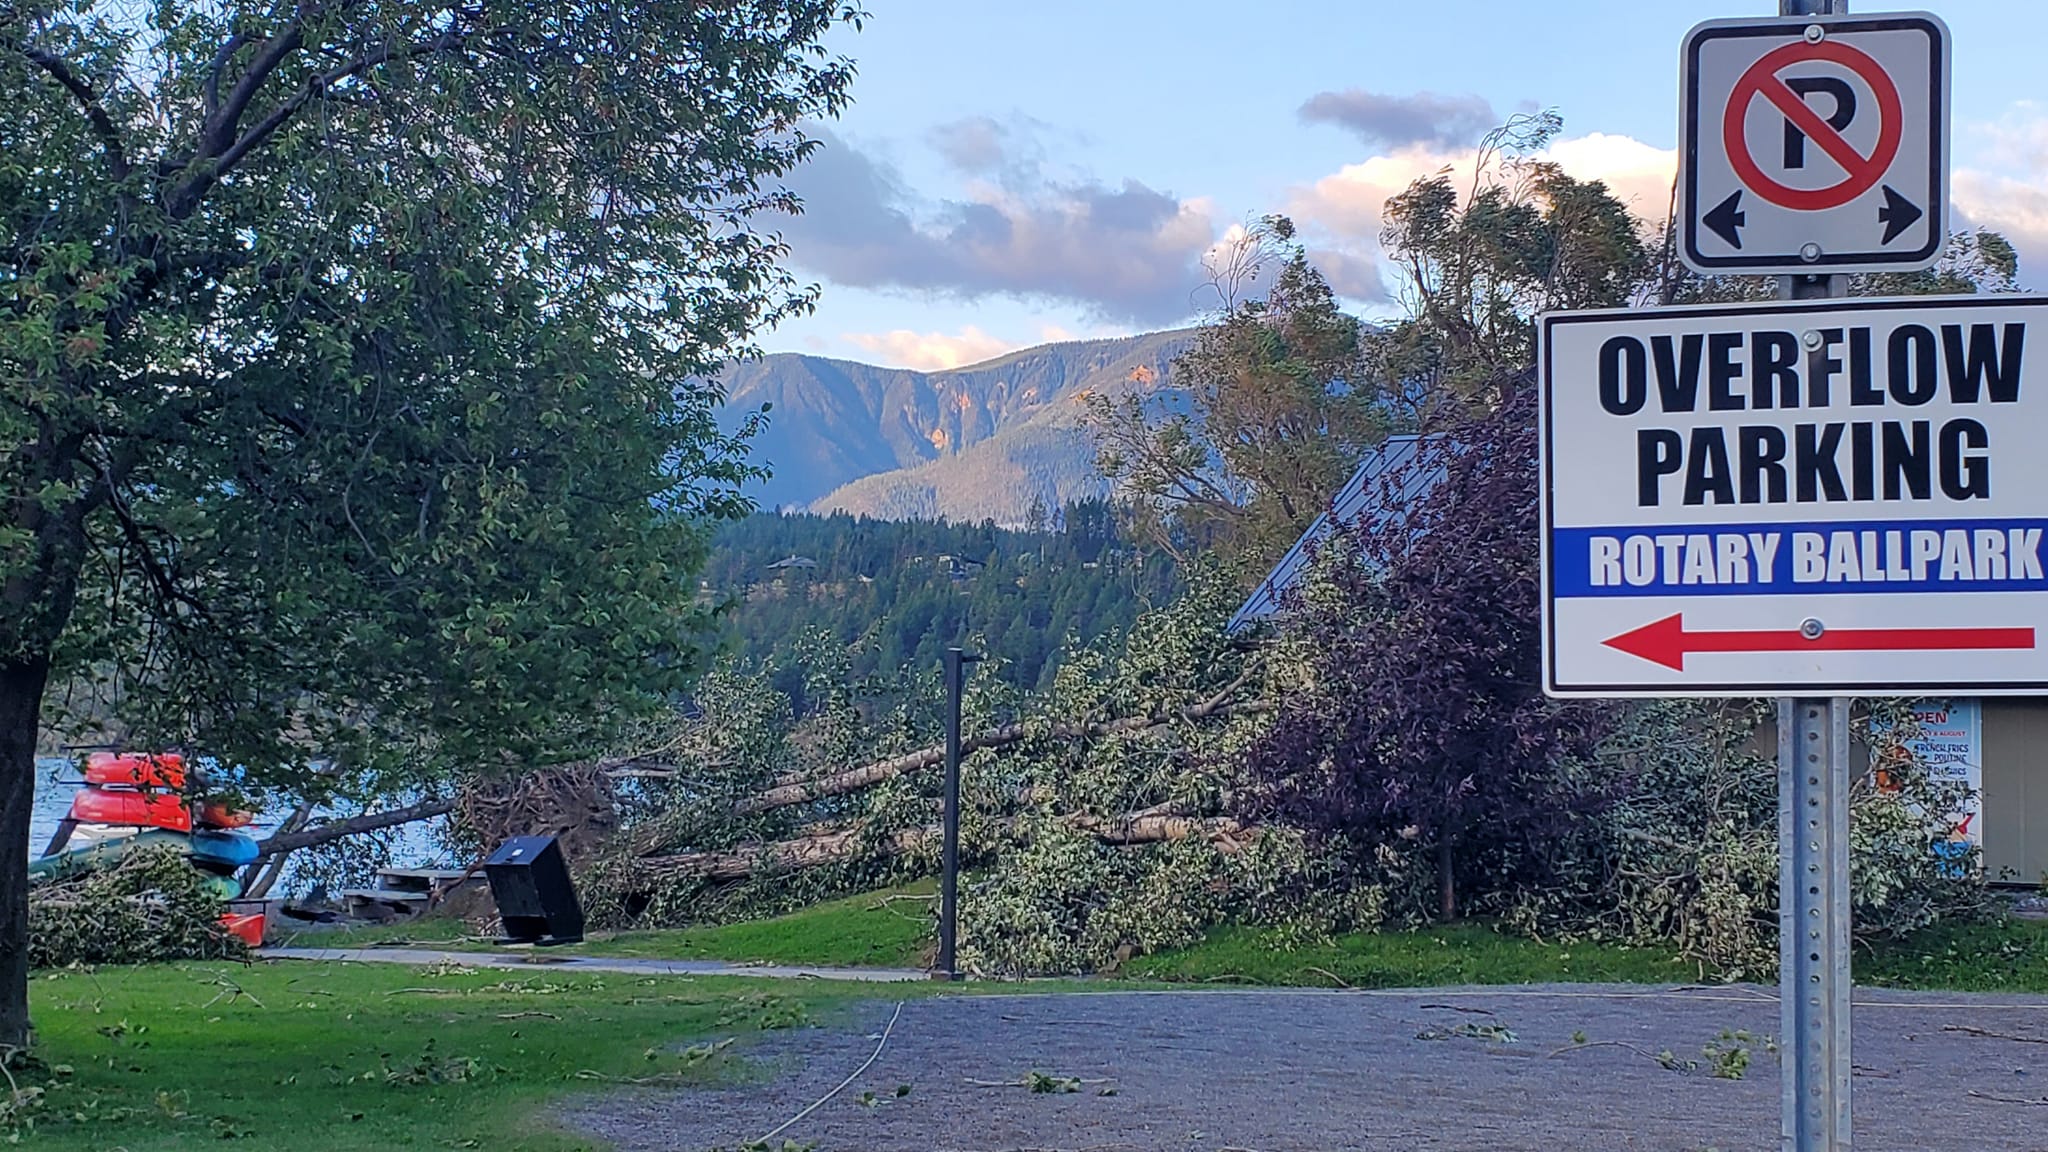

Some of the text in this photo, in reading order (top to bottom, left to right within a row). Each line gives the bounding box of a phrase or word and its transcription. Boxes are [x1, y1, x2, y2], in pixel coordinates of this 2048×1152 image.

[1783, 76, 1857, 169] P
[1598, 322, 2026, 416] OVERFLOW
[1637, 418, 1990, 506] PARKING
[1589, 528, 2045, 587] ROTARY BALLPARK
[1913, 711, 1947, 723] PEN
